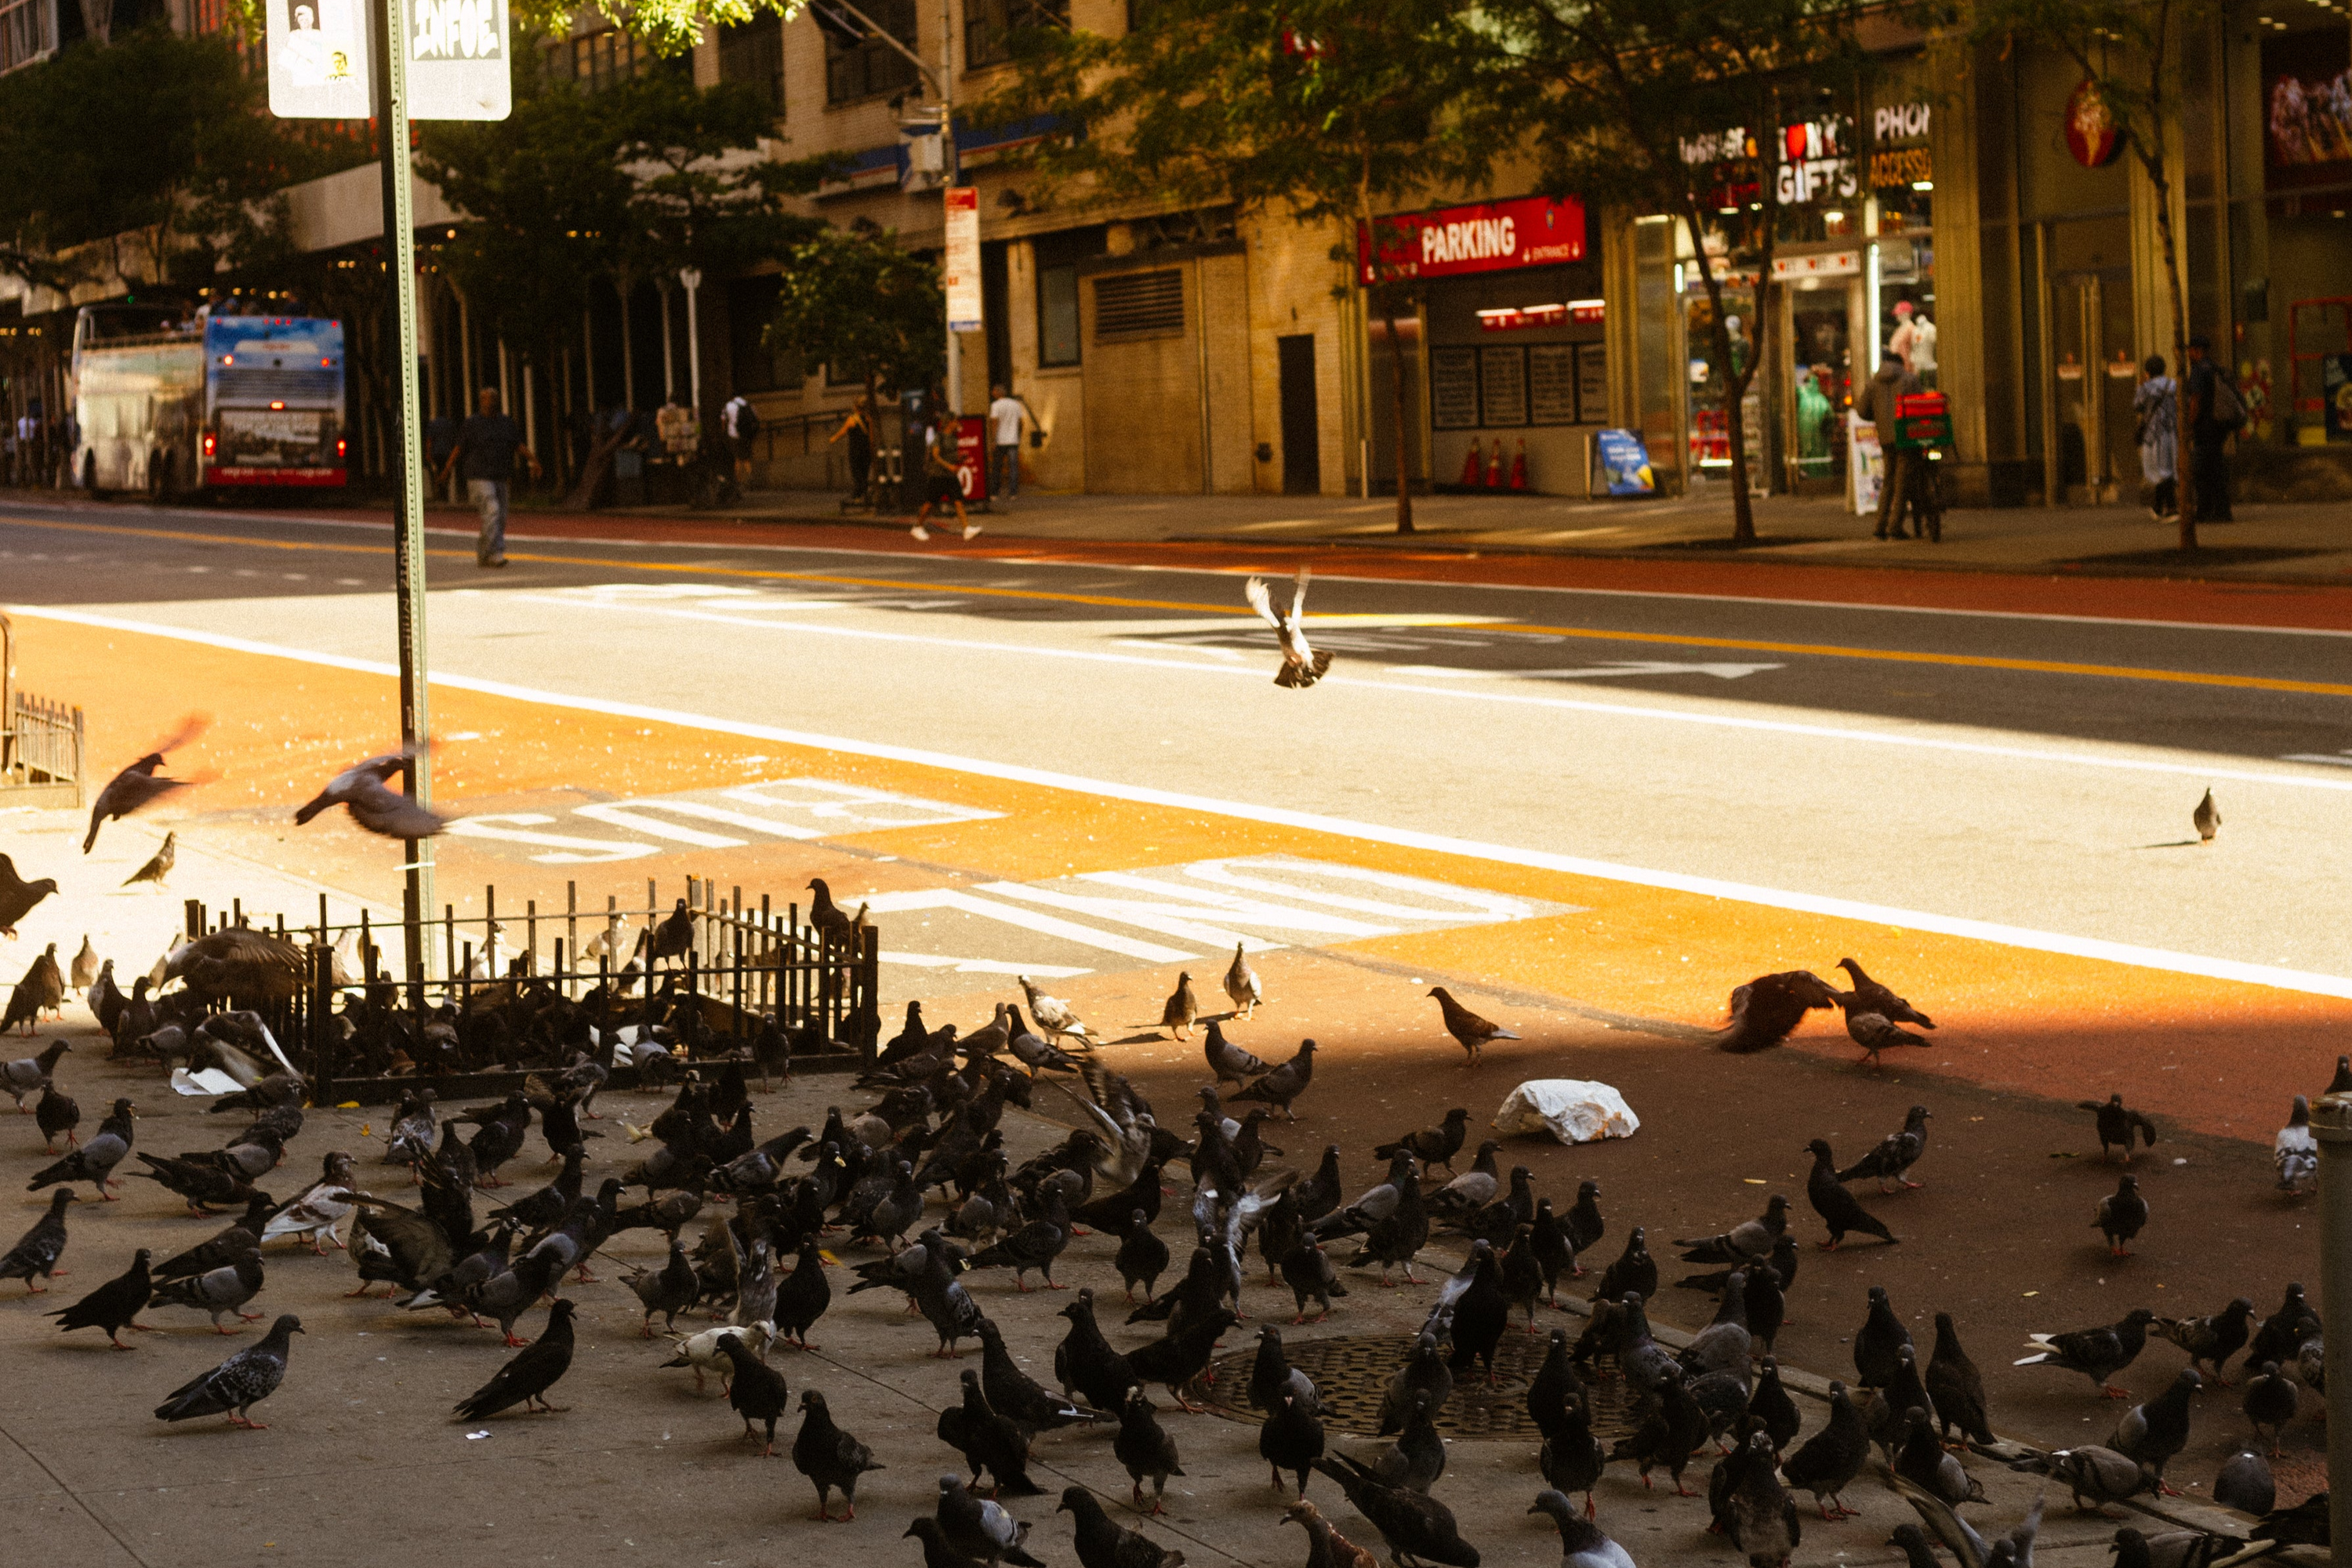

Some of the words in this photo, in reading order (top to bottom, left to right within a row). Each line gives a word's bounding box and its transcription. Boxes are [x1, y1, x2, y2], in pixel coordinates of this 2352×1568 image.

[1776, 158, 1858, 205] GIFTS
[1421, 216, 1516, 265] PARKING
[443, 776, 1014, 864] BUS
